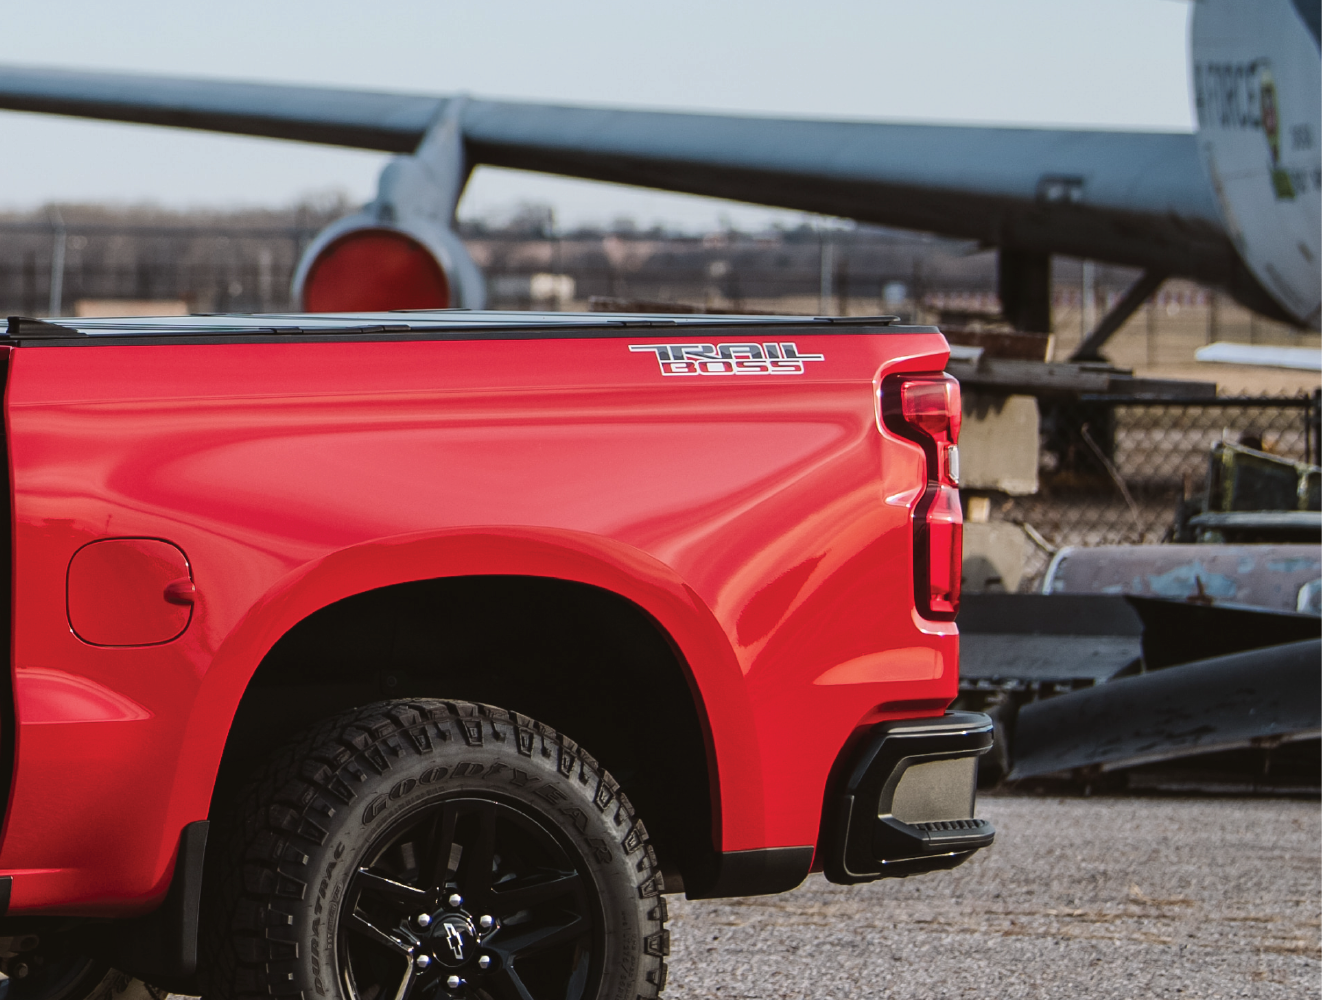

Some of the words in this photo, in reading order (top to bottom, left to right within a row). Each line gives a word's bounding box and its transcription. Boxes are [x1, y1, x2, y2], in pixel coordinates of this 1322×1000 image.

[628, 342, 825, 361] TRAIL
[660, 360, 804, 376] BOSS
[362, 761, 612, 864] GOODYEAR
[311, 841, 345, 996] DURATRAC
